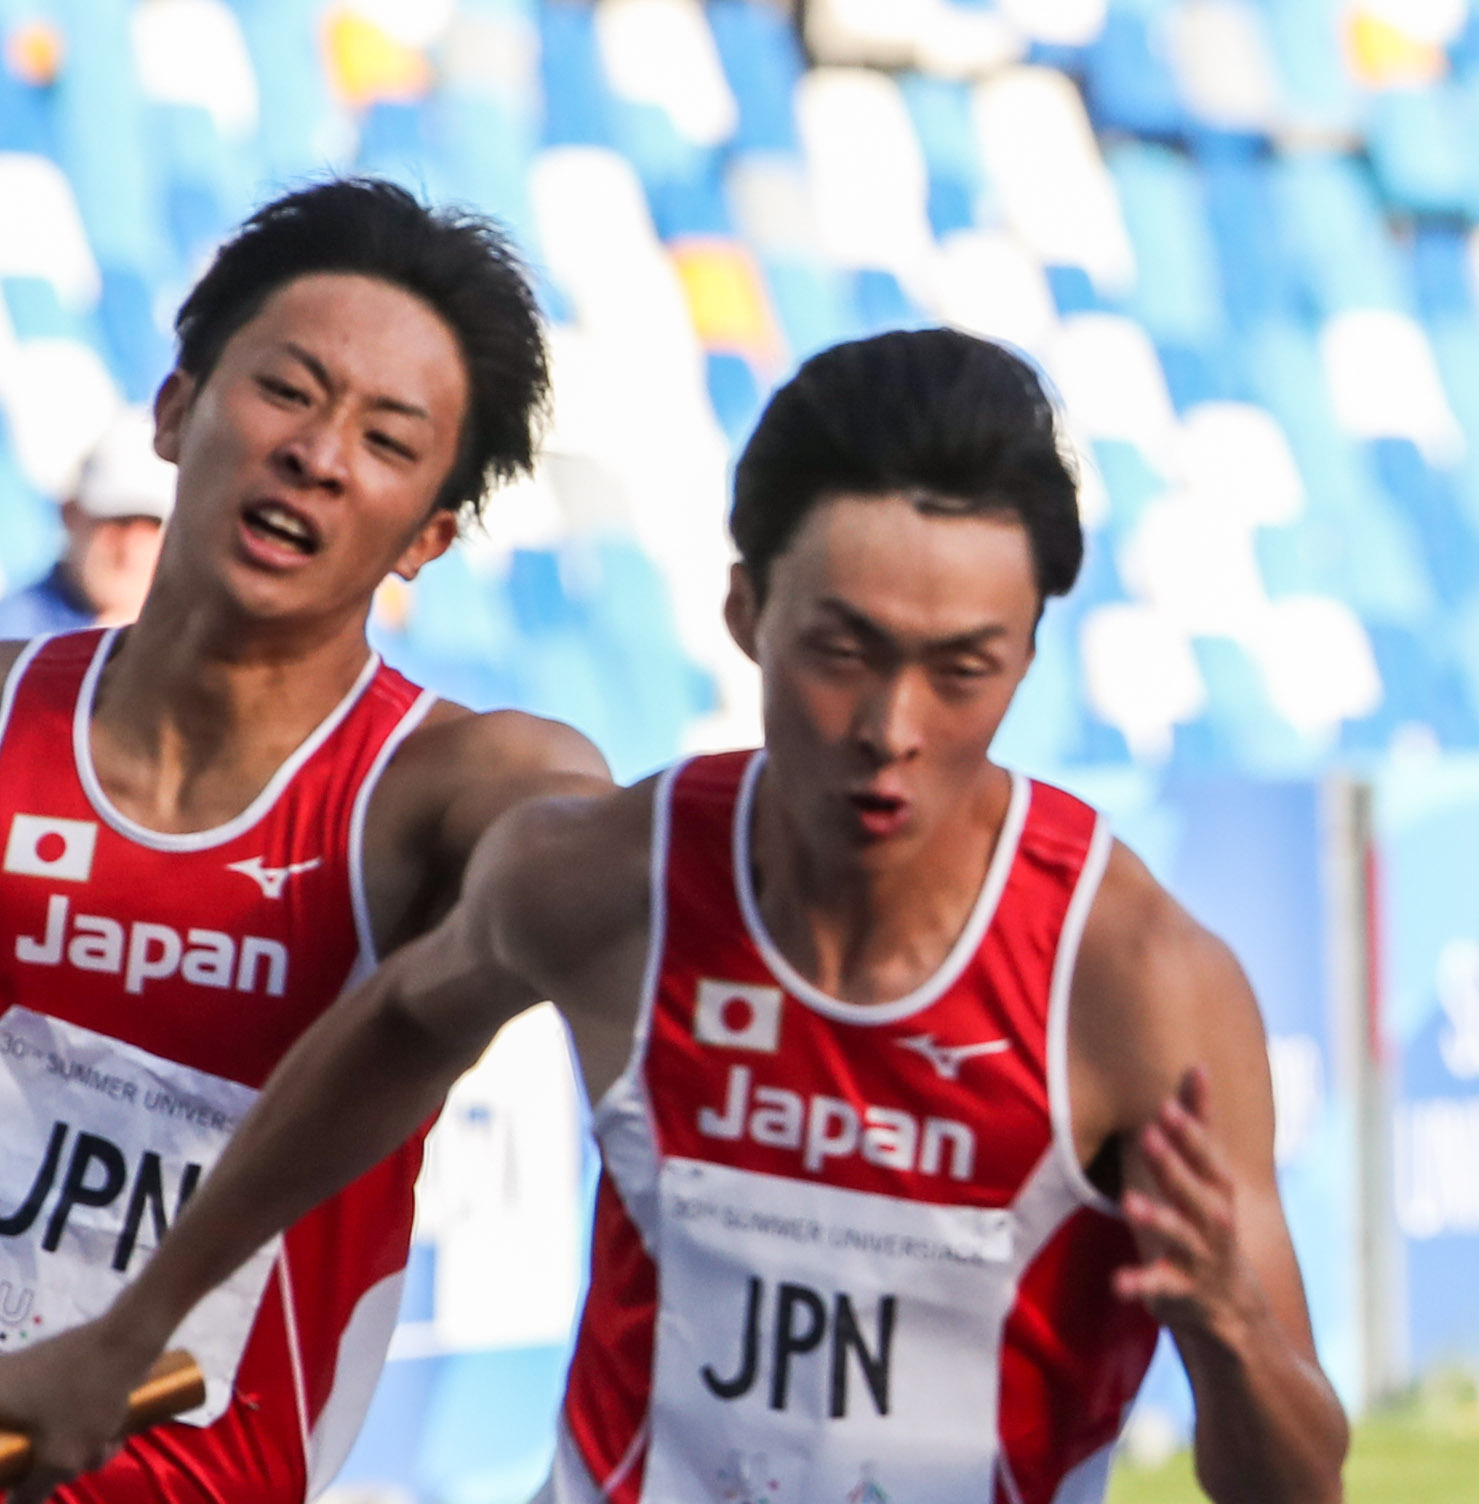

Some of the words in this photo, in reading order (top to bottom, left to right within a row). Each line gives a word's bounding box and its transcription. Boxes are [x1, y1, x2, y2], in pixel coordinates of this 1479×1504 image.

[14, 893, 290, 997] Japan
[46, 1051, 139, 1102] SUMMER
[143, 1089, 233, 1129] UNIVER
[698, 1066, 976, 1182] Japan
[0, 1121, 202, 1272] JPN
[700, 1274, 898, 1420] JPN
